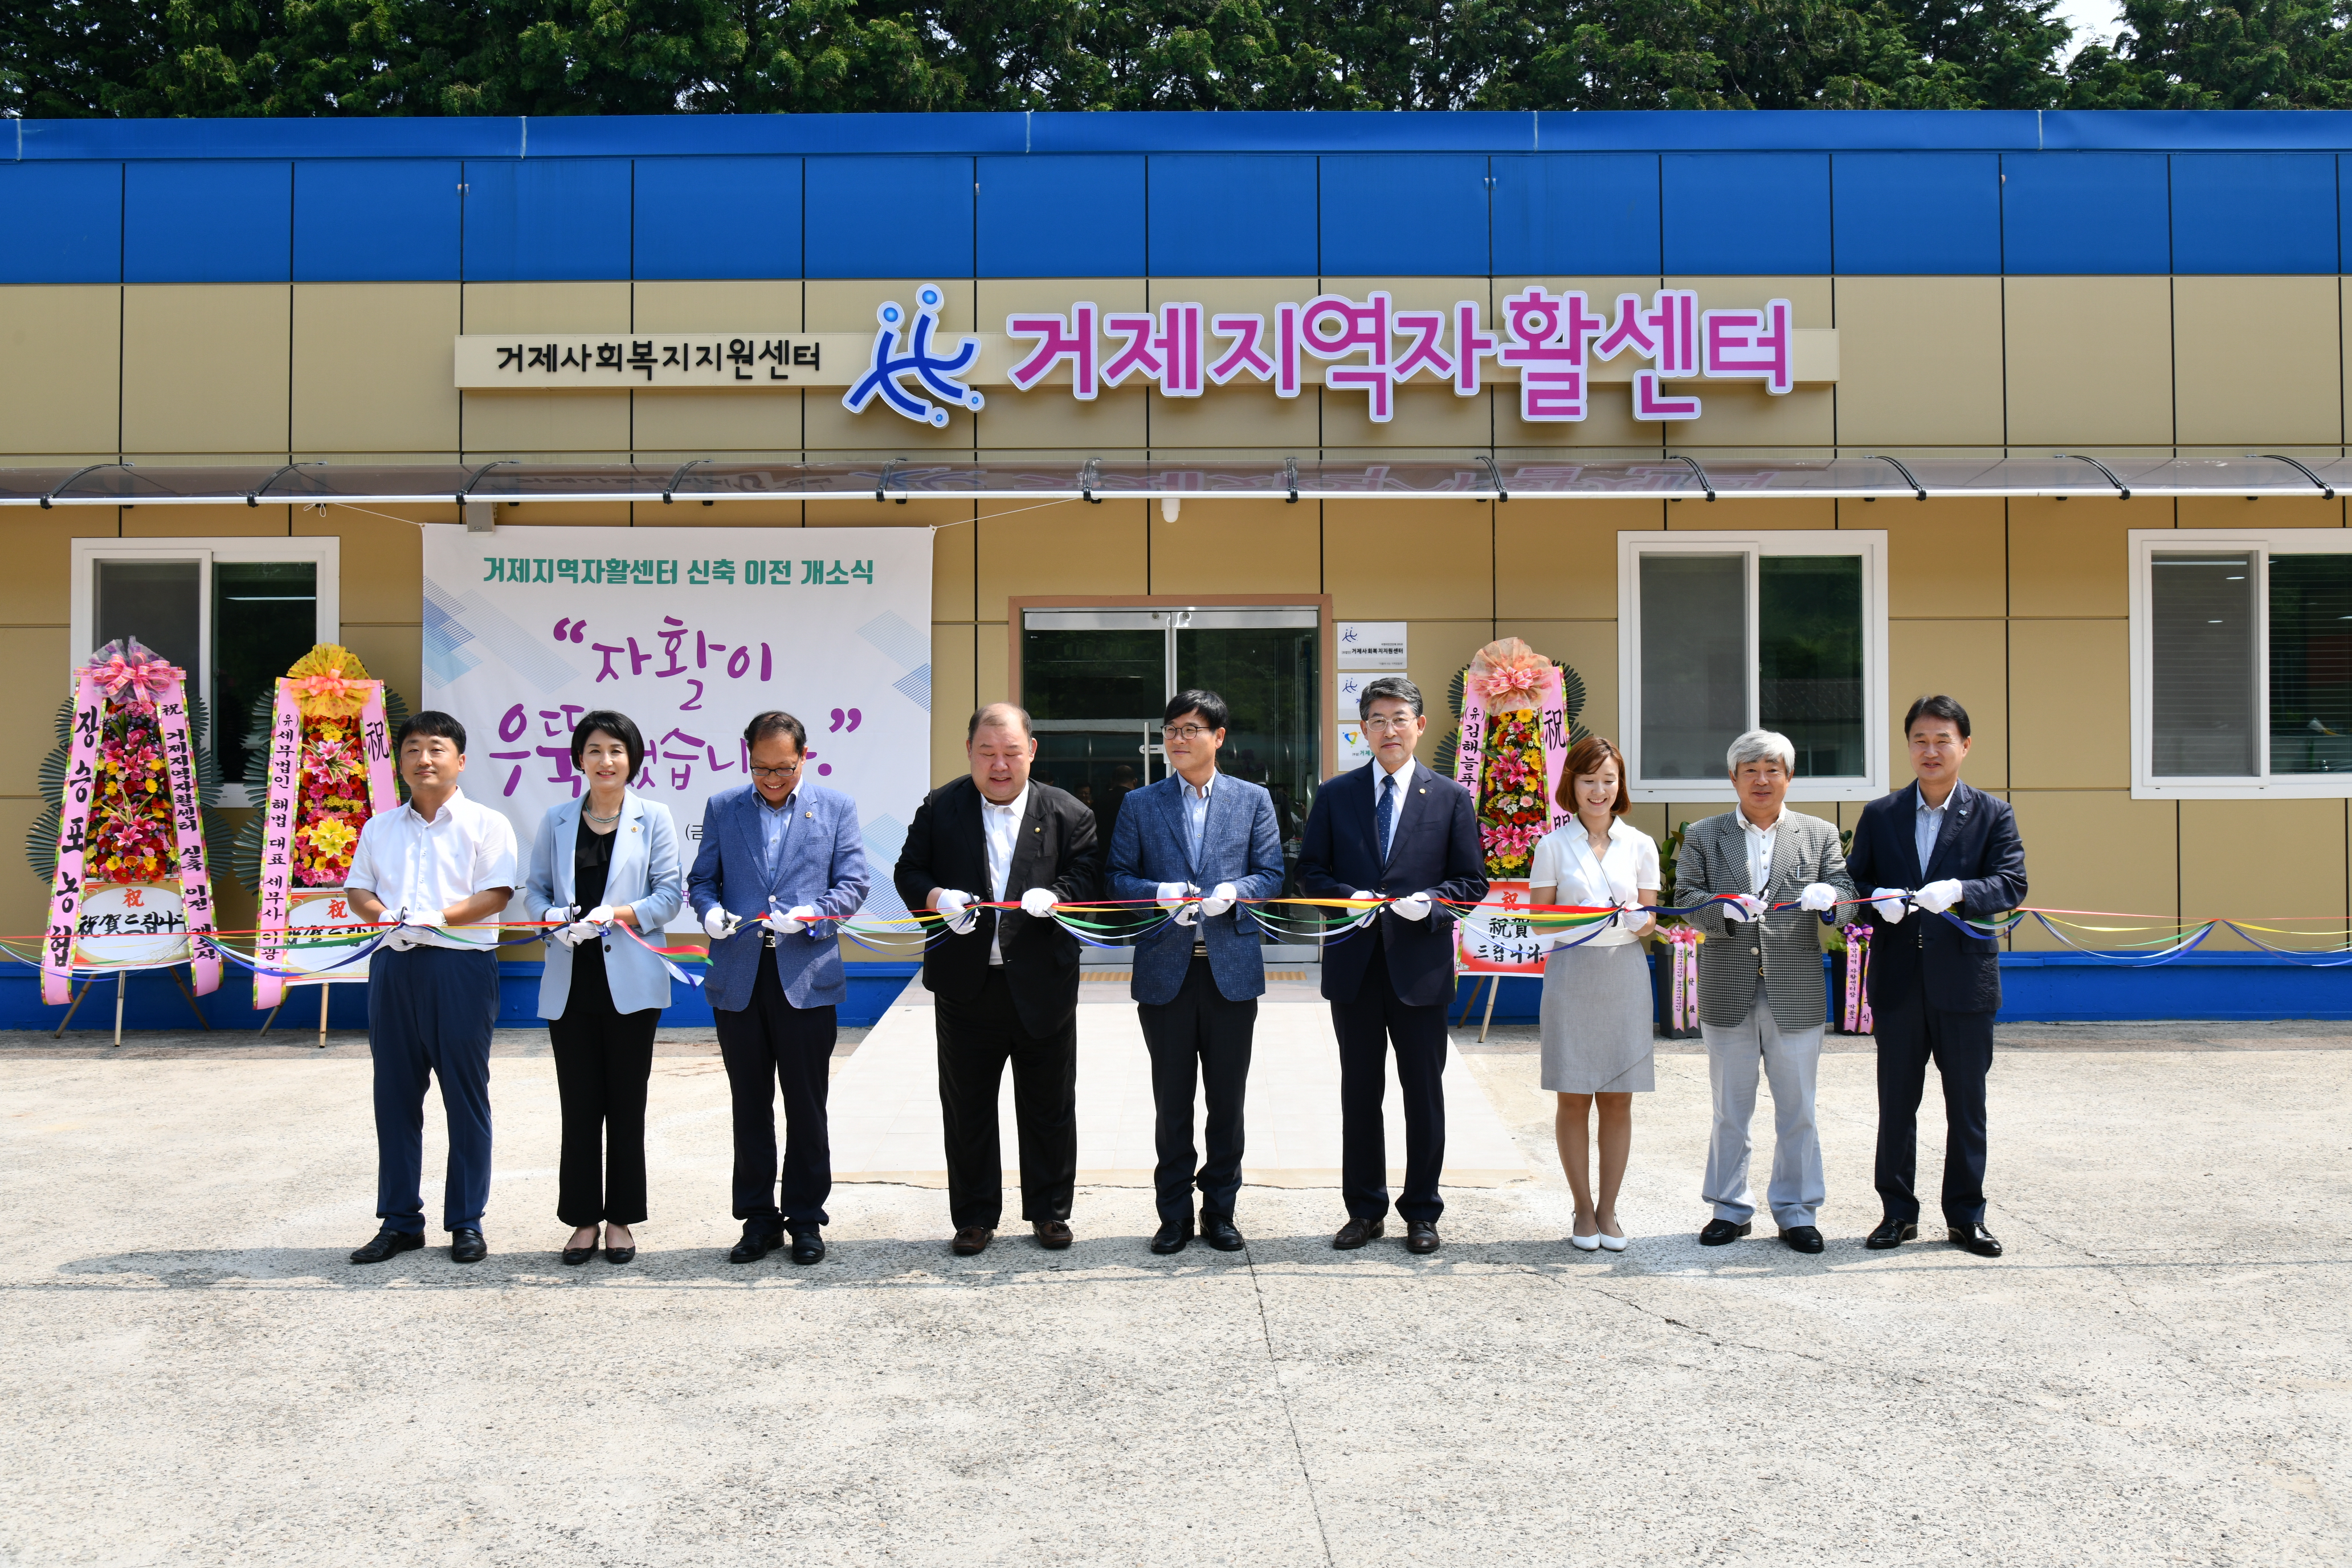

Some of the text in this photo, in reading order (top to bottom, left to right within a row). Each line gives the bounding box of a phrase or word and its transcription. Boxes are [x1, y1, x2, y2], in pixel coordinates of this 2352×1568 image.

[497, 338, 819, 381] 거제사회복지지원센터
[1008, 287, 1792, 420] 거제지역자활센터
[483, 557, 873, 586] 거제지역자활센터 신축 이전 개소식
[161, 703, 183, 716] 祝
[365, 720, 390, 762] 祝
[1543, 708, 1566, 752] 祝
[166, 728, 198, 832] 거제지역자활센터
[271, 798, 289, 828] 해법
[180, 845, 204, 872] 신축
[266, 836, 287, 865] 대표
[121, 887, 145, 908] 祝
[185, 884, 208, 911] 이전
[262, 875, 284, 921] 세무사
[325, 899, 349, 920] 祝
